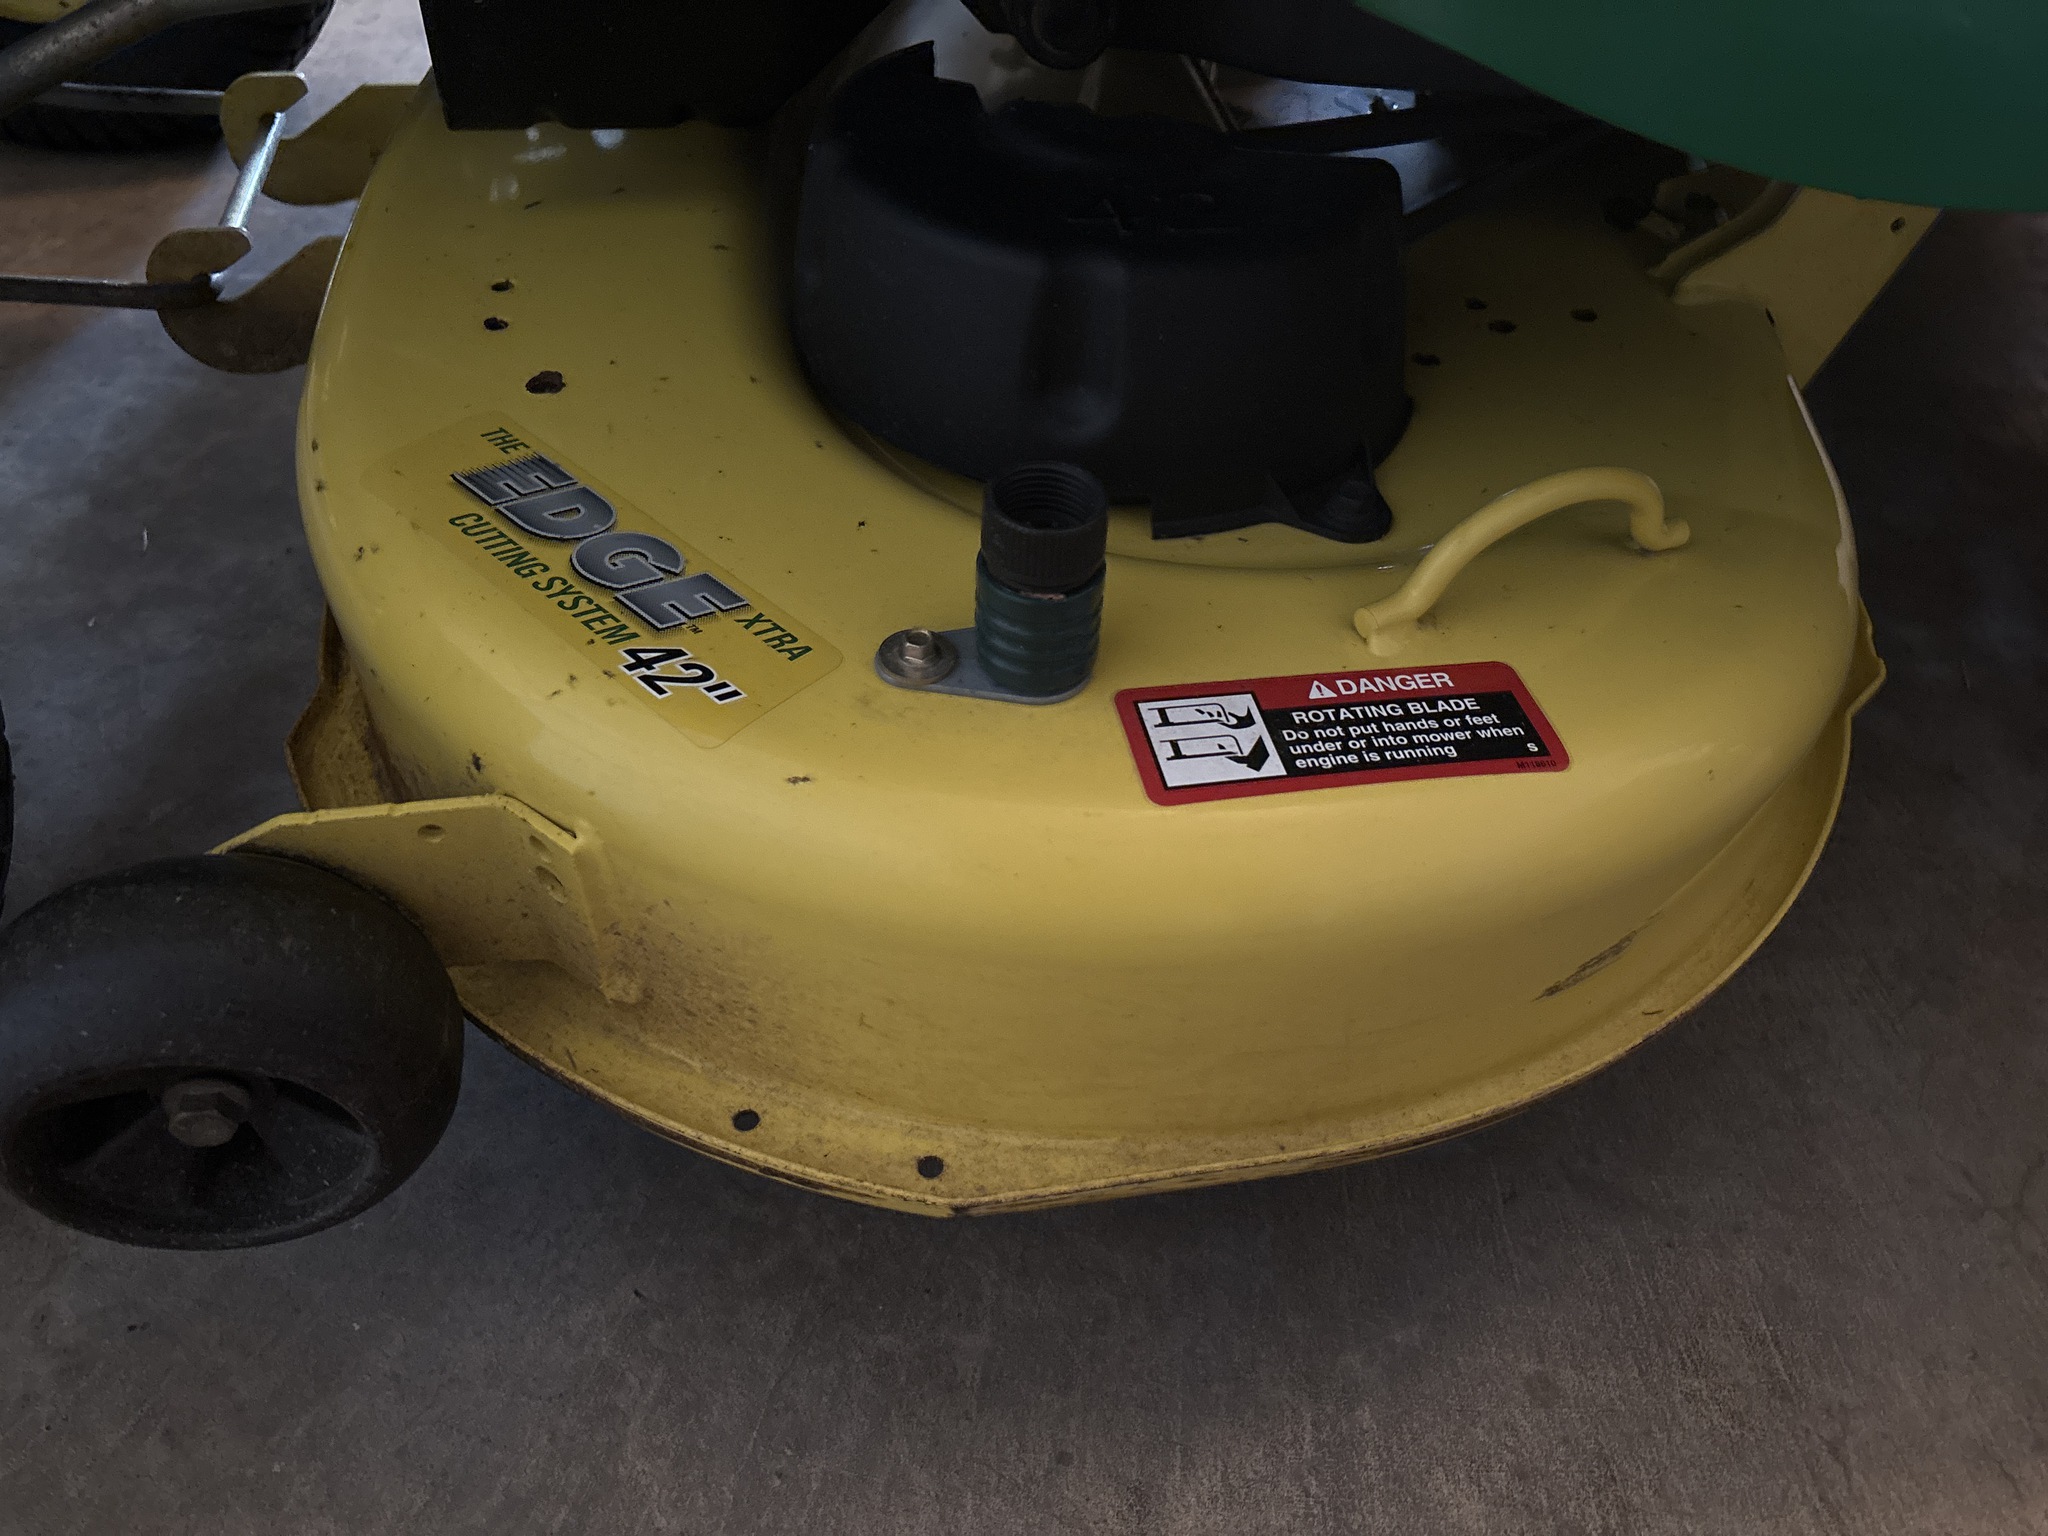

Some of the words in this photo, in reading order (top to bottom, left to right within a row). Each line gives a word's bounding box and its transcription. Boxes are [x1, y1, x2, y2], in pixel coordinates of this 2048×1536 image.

[480, 427, 530, 455] THE
[449, 451, 750, 633] EDGE
[448, 512, 550, 579] CUTTING
[532, 576, 641, 646] SYSTEM
[734, 612, 814, 662] XTRA
[1334, 671, 1455, 696] DANGER
[1281, 728, 1310, 742] Do
[1313, 725, 1346, 740] not
[1349, 721, 1380, 740] put
[1382, 716, 1440, 734] hands
[1443, 715, 1462, 729] or
[1464, 711, 1501, 726] feet
[1290, 703, 1405, 725] ROTATING
[1406, 697, 1481, 716] BLADE
[1288, 740, 1343, 756] under
[1347, 738, 1368, 751] or
[1371, 733, 1409, 749] into
[1412, 727, 1473, 745] mower
[1476, 725, 1525, 740] when
[1295, 751, 1360, 769] engine
[1363, 749, 1380, 763] is
[1383, 743, 1458, 762] running
